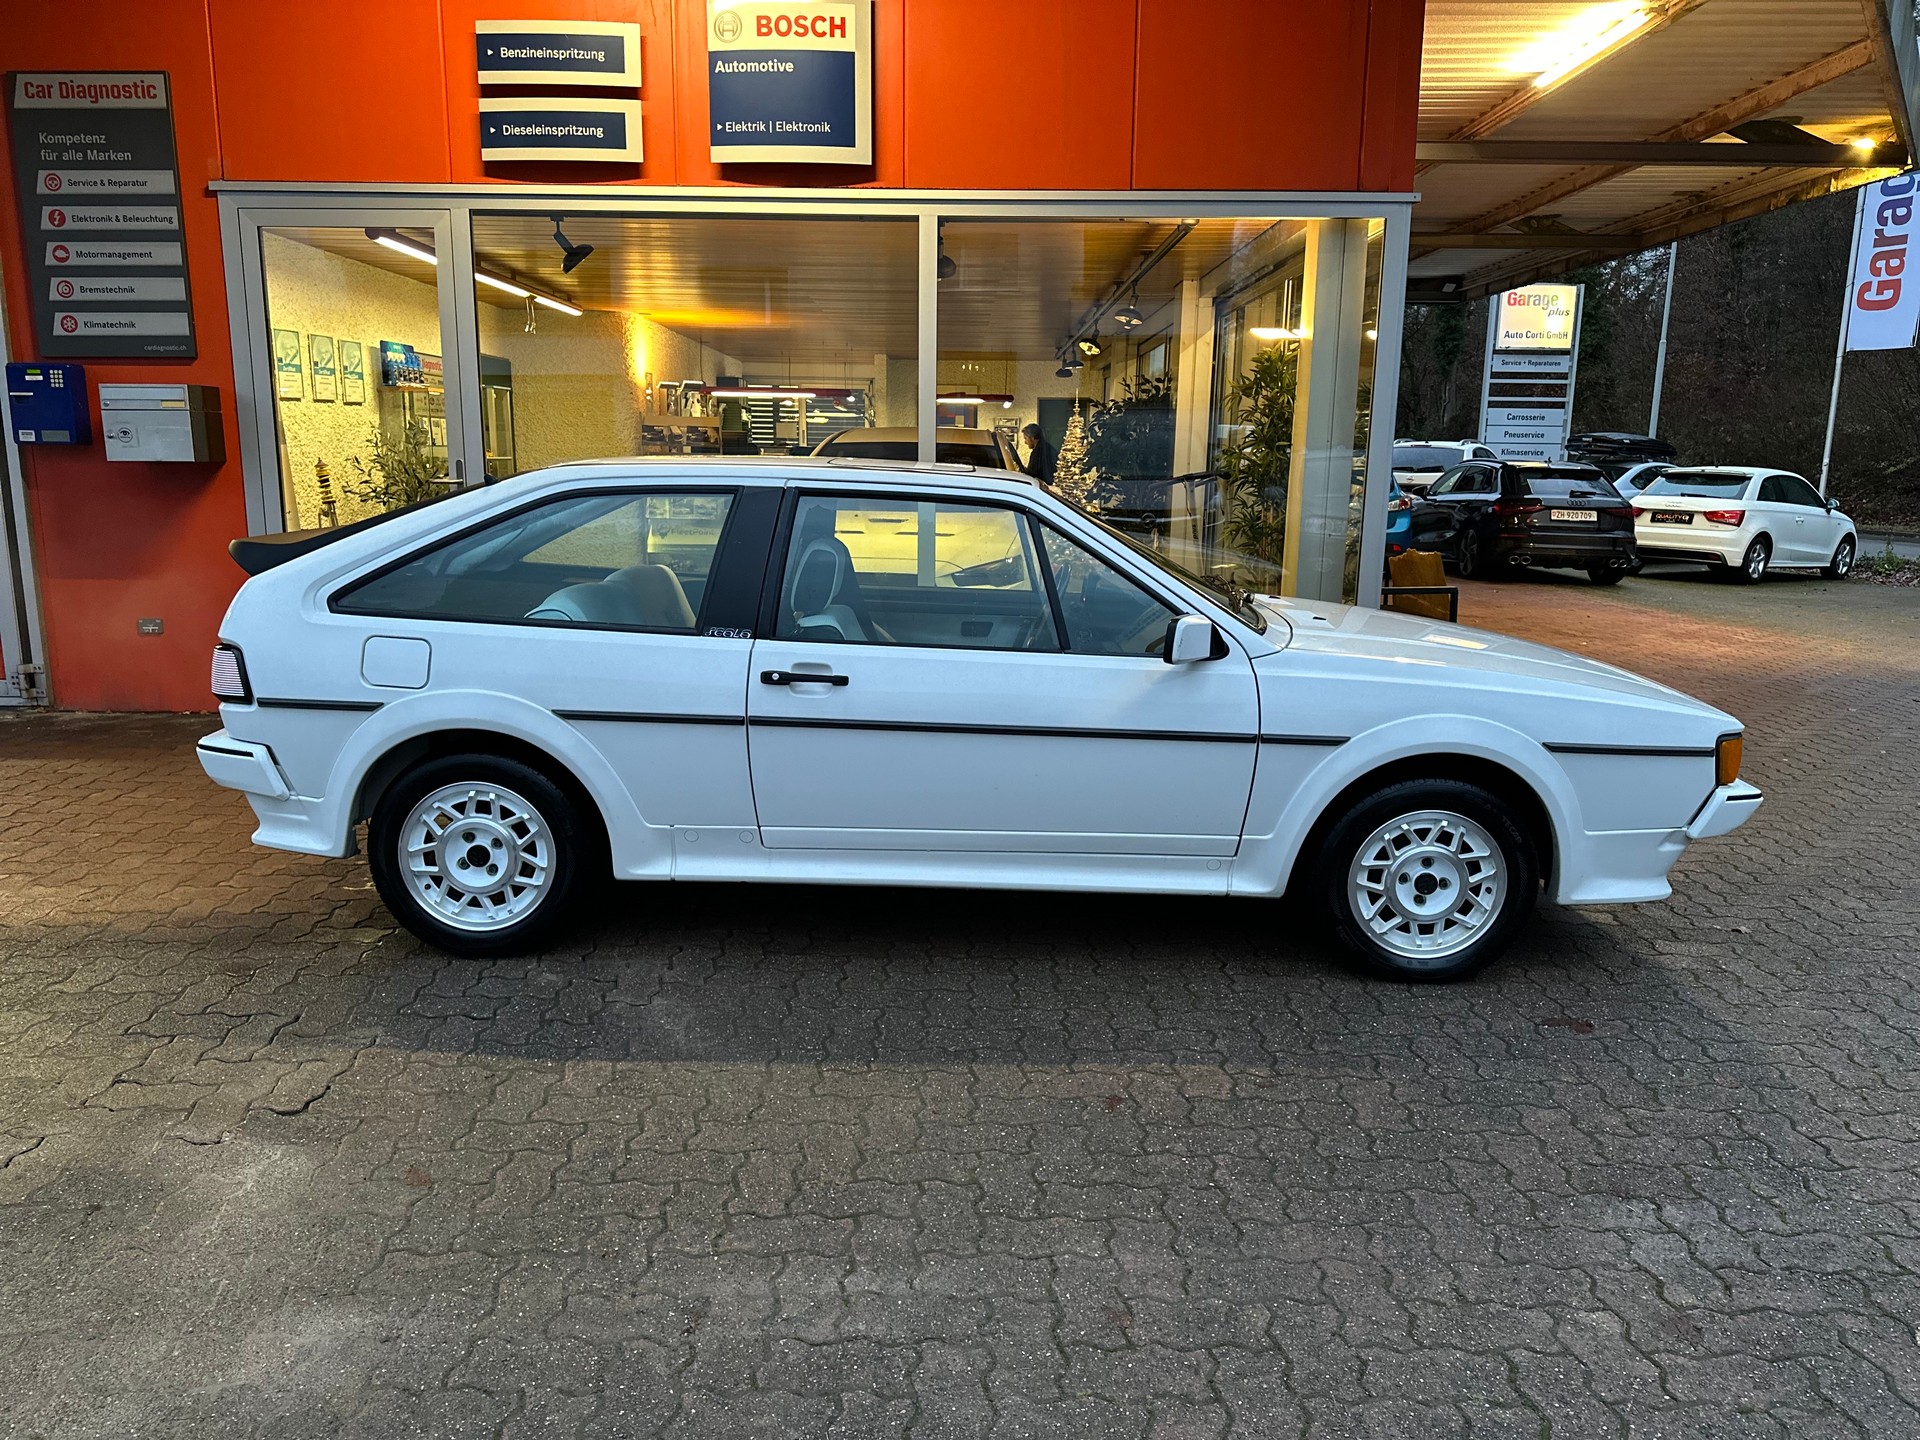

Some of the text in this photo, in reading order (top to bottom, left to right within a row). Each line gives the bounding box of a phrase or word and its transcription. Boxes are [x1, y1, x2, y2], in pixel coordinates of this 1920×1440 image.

[756, 15, 846, 38] BOSCH
[500, 46, 606, 62] Benzineinspritzung
[714, 59, 795, 74] Automotive
[24, 81, 157, 104] Car Diagnostic
[502, 124, 604, 139] Dieseleinspritzung
[725, 121, 767, 133] Elektrik
[775, 121, 831, 133] Elektronik
[38, 132, 107, 146] Kompetenz
[40, 149, 132, 161] für alle Marken
[67, 178, 148, 190] Service & Reparatur
[71, 214, 174, 226] Elektronik & Beleuchtung
[75, 249, 153, 261] Motormanagement
[79, 284, 136, 295] Bremstechnik
[1507, 291, 1559, 311] Garage
[1547, 307, 1570, 318] plus
[83, 320, 137, 330] Klimatechnik
[1503, 330, 1568, 340] Auto Corti GmbH
[1501, 359, 1522, 367] Service
[1527, 359, 1561, 368] Reparaturen
[1506, 413, 1546, 422] Carrosserie
[1503, 430, 1545, 440] Pneuservice
[1501, 448, 1545, 457] Klimaservice
[1556, 511, 1565, 519] ZH
